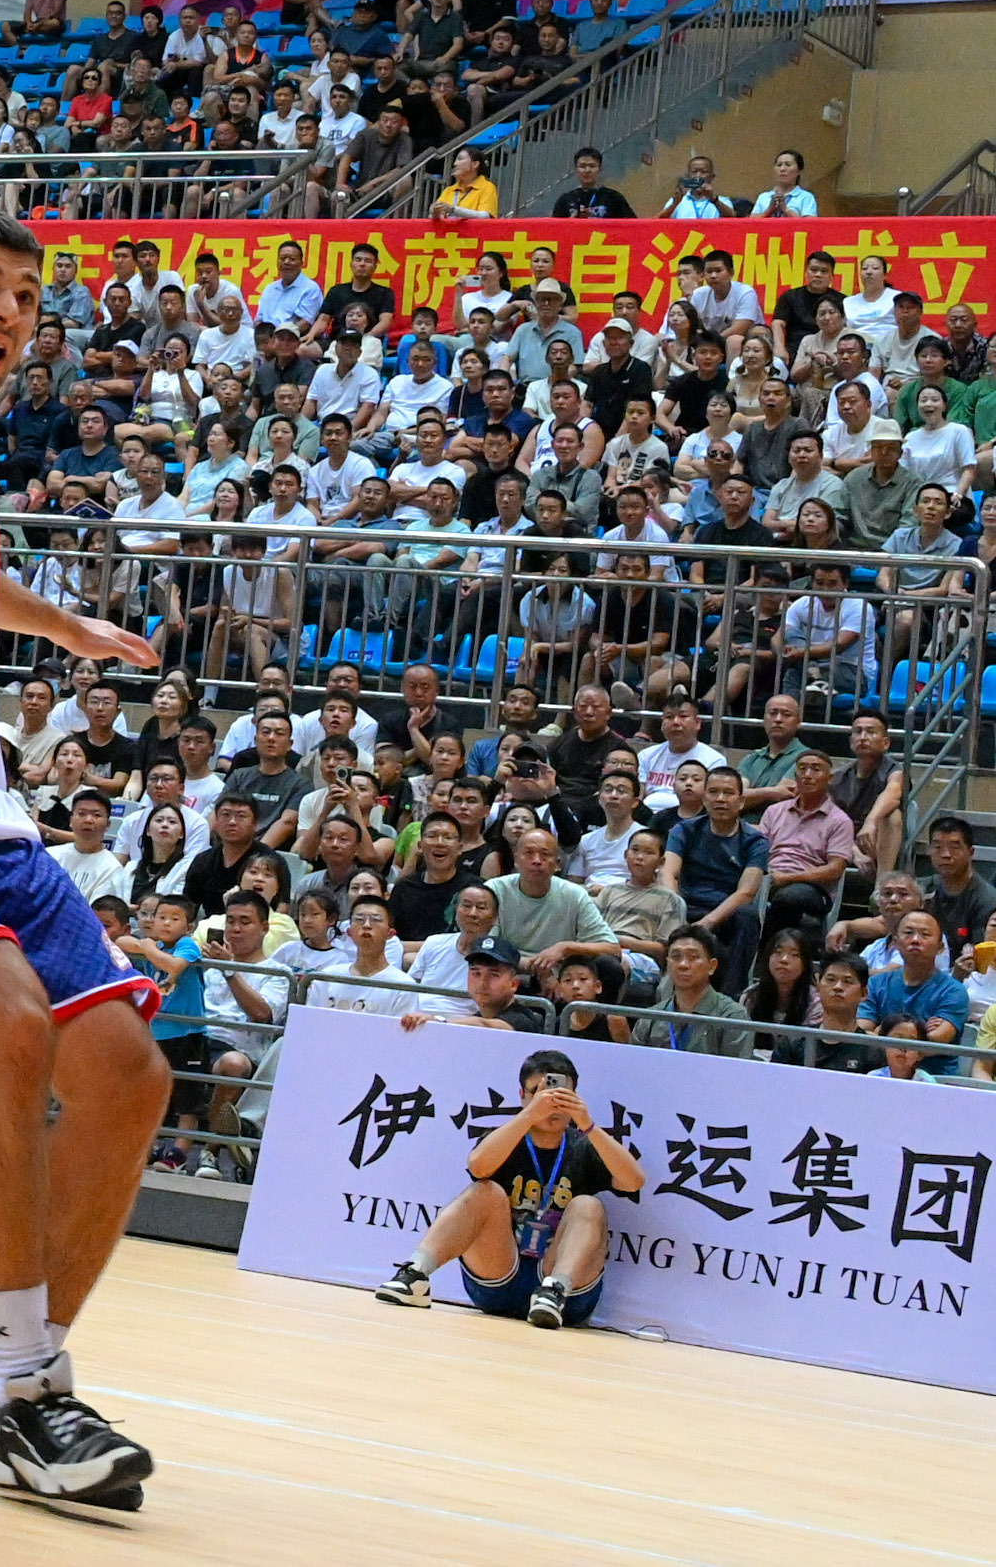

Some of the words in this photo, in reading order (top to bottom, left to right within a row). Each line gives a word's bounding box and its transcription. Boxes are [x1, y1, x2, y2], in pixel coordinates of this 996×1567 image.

[342, 1193, 442, 1233] YINN
[692, 1243, 784, 1287] YUN
[787, 1260, 827, 1299] JI
[840, 1267, 971, 1317] TUAN
